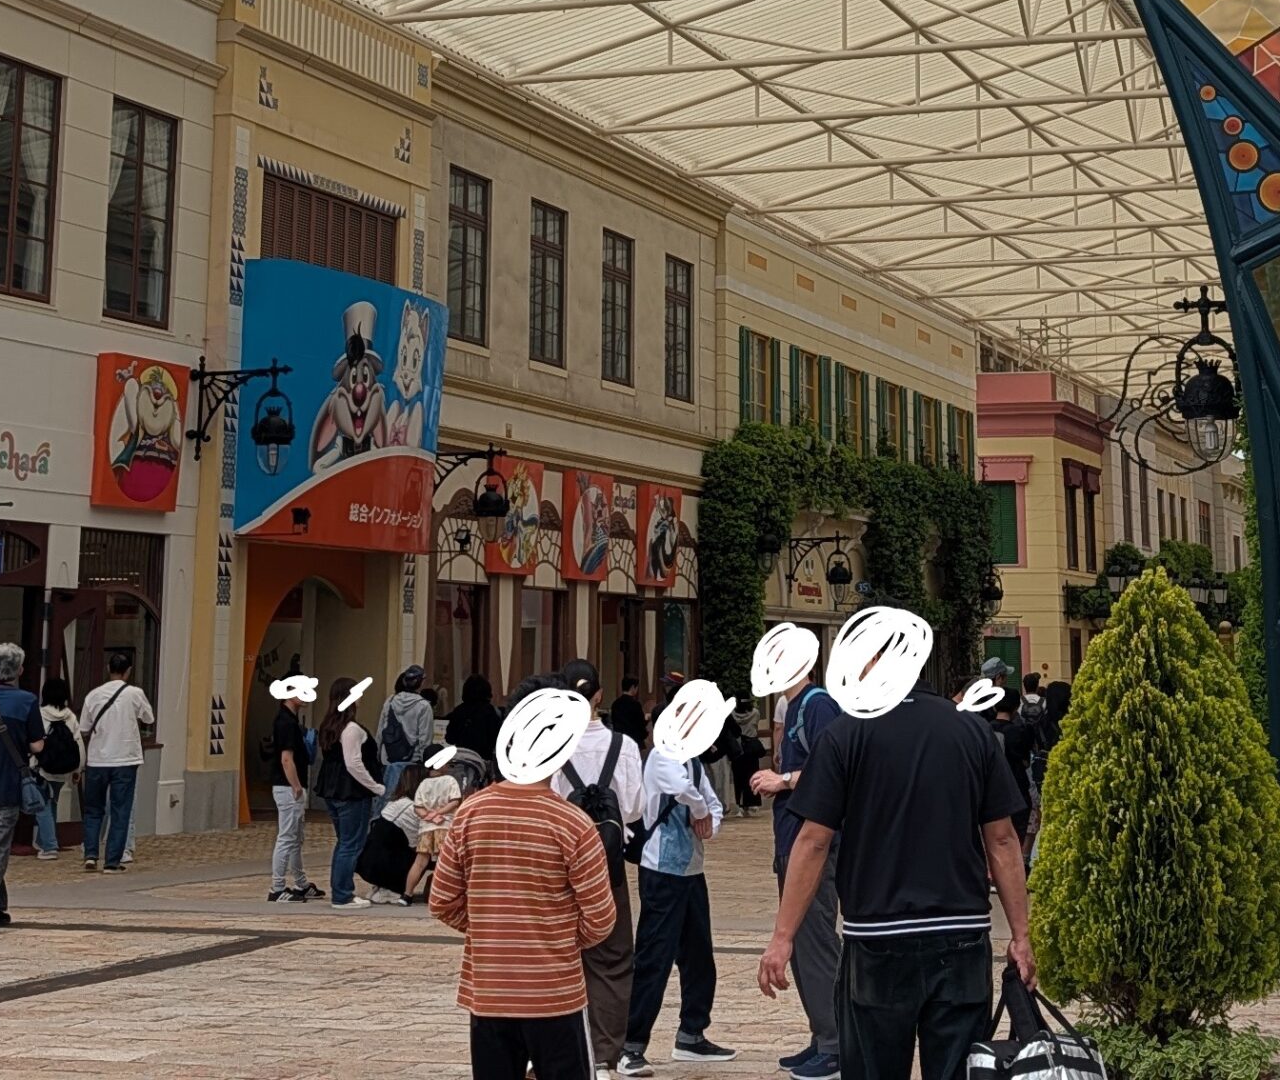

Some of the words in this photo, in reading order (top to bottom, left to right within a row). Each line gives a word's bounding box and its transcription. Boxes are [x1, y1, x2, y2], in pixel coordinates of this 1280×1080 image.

[348, 503, 423, 529] 総合インフォメーション
